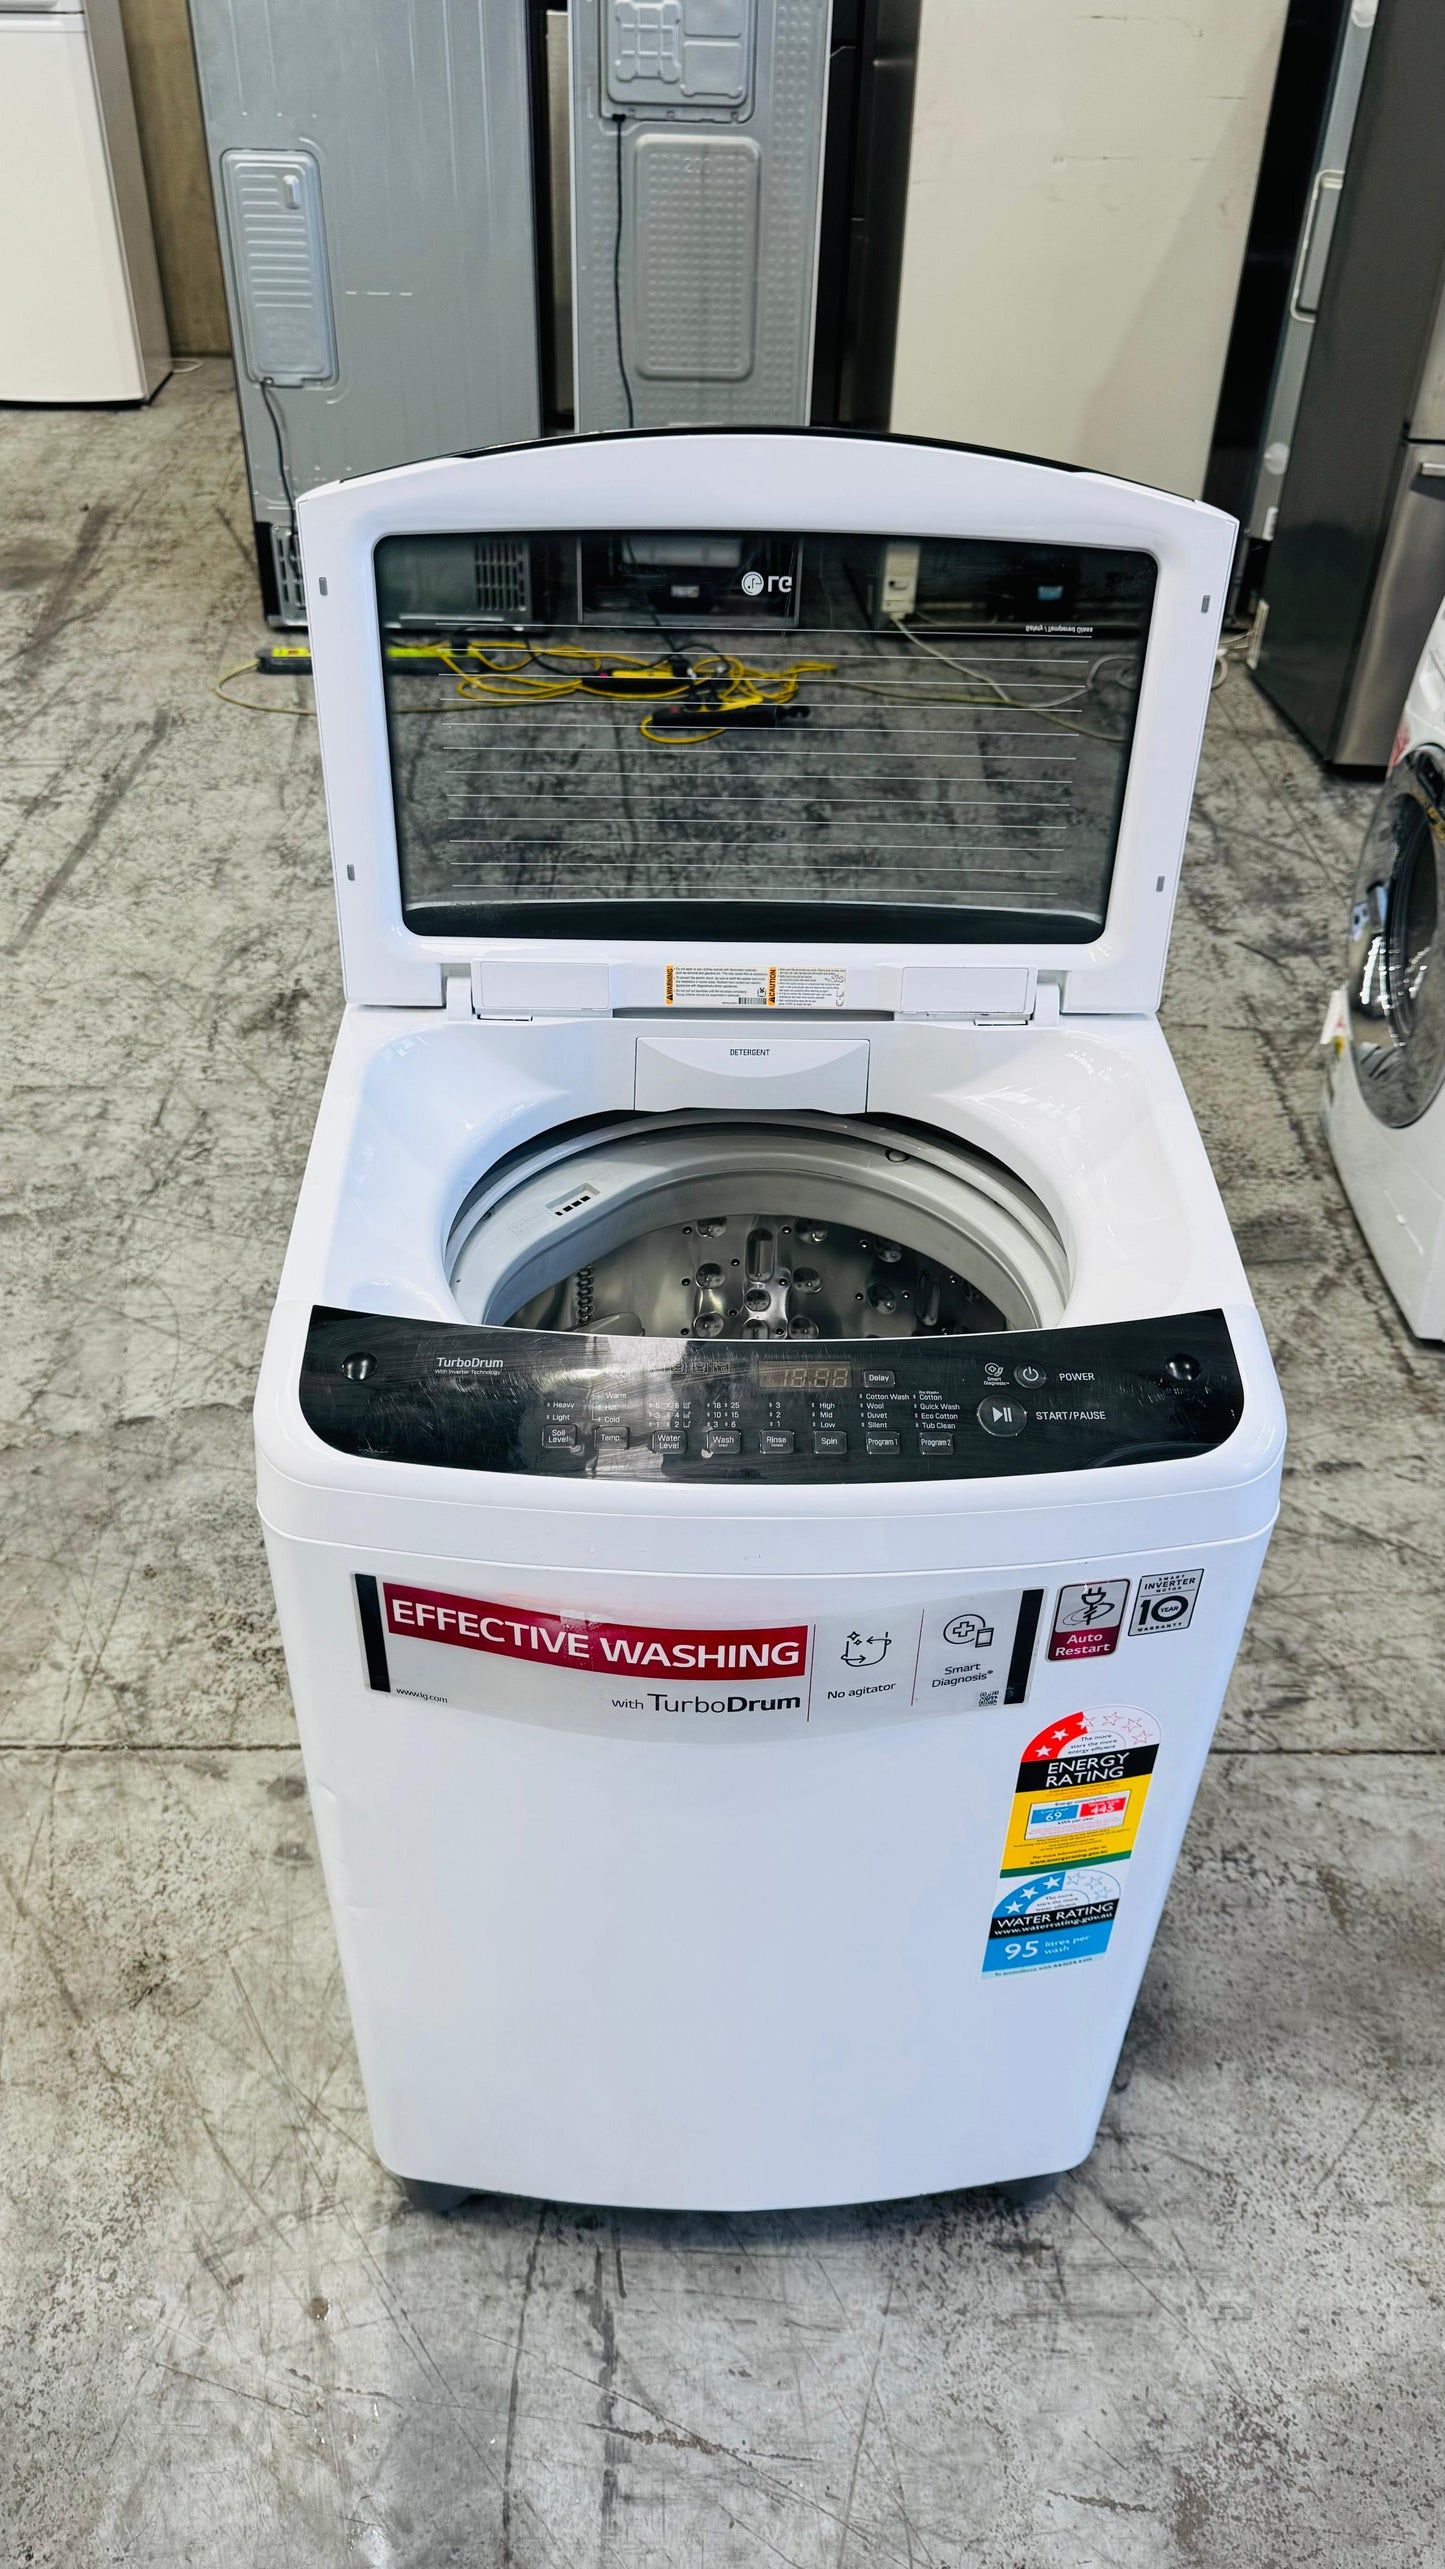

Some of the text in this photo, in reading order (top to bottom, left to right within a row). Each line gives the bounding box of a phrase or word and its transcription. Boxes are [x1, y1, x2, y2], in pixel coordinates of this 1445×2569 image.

[730, 1048, 770, 1056] DETERGENT
[437, 1357, 504, 1368] TurboDrum
[869, 1374, 889, 1382] Delay
[1059, 1373, 1095, 1381] POWER
[820, 1402, 835, 1410] High
[1036, 1411, 1106, 1420] START/PAUSE
[821, 1438, 838, 1446] Spin
[868, 1439, 894, 1447] Program
[921, 1439, 946, 1447] Program
[1158, 1574, 1185, 1582] SMART
[1144, 1578, 1196, 1590] INVERTER
[1138, 1595, 1189, 1625] 10
[1161, 1605, 1179, 1613] YEAR
[1138, 1622, 1183, 1632] WARRANTY
[392, 1599, 799, 1668] EFFECTIVE WASHING
[1067, 1633, 1103, 1644] Auto
[1055, 1643, 1111, 1656] Restart
[944, 1663, 981, 1675] Smart
[396, 1688, 448, 1703] www.lg.com
[828, 1683, 896, 1699] No agitator
[611, 1693, 800, 1714] with TurboDrum
[1048, 1752, 1130, 1774] ENERGY
[1046, 1766, 1124, 1788] RATING
[1091, 1804, 1115, 1814] 445
[1046, 1812, 1062, 1821] 69
[997, 1902, 1114, 1928] WATER RATING
[1045, 1936, 1091, 1947] litres per
[1005, 1940, 1039, 1960] 95
[1044, 1946, 1070, 1955] wash
